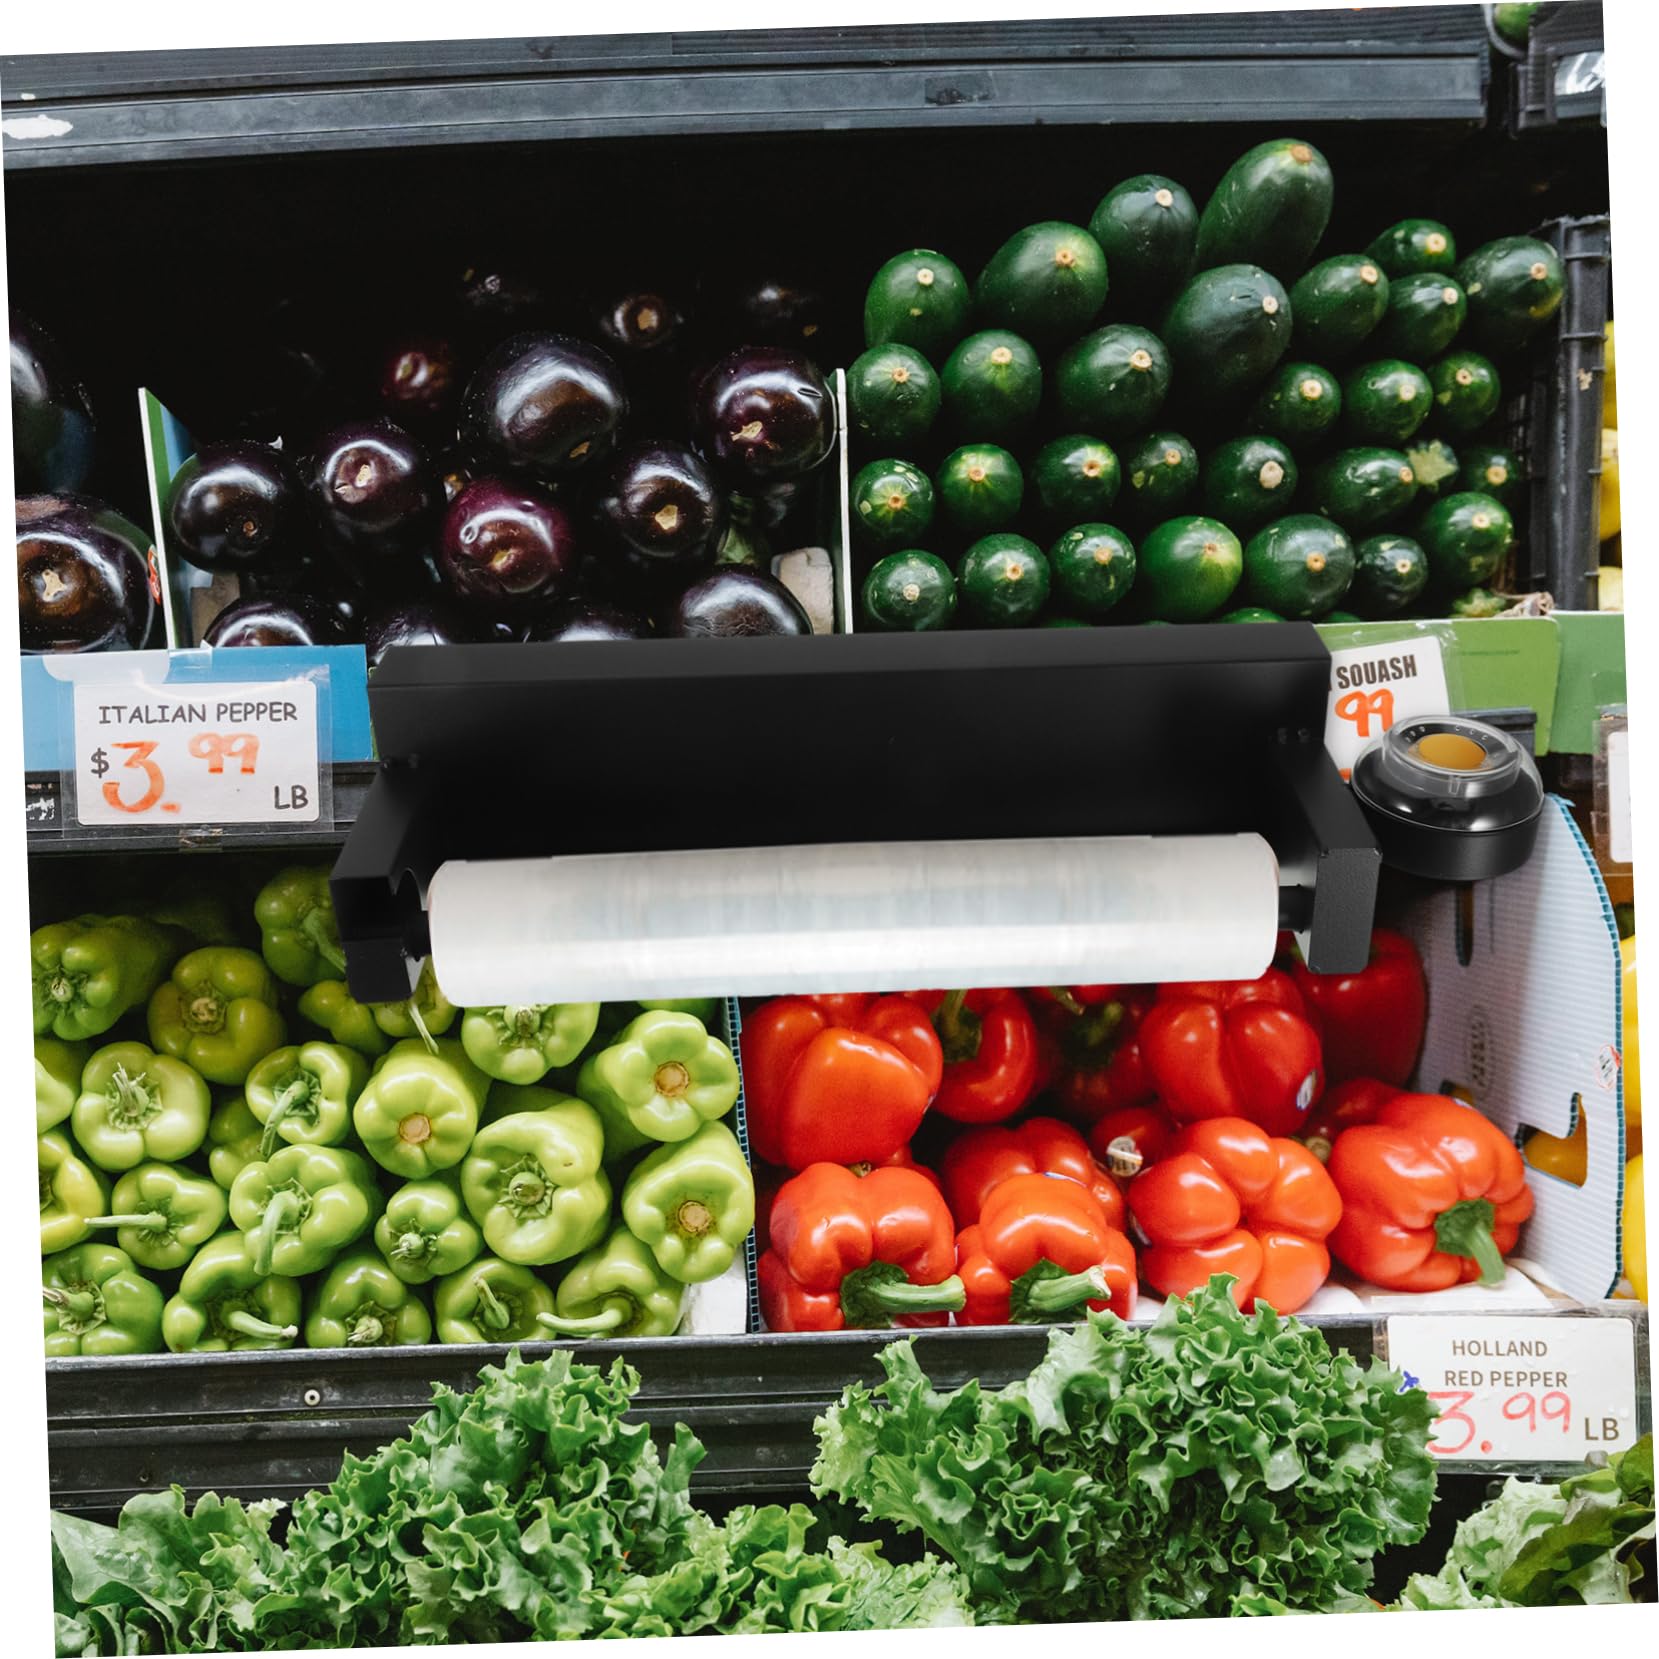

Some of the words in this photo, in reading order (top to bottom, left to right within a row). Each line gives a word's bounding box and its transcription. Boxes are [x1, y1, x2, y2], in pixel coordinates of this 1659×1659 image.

[99, 705, 206, 724] ITALIAN
[217, 702, 297, 722] PEPPER
[274, 785, 308, 810] LB
[1452, 1340, 1548, 1357] HOLLAND
[1445, 1371, 1483, 1386] RED
[1490, 1371, 1568, 1387] PEPPER
[1585, 1418, 1619, 1441] LB
